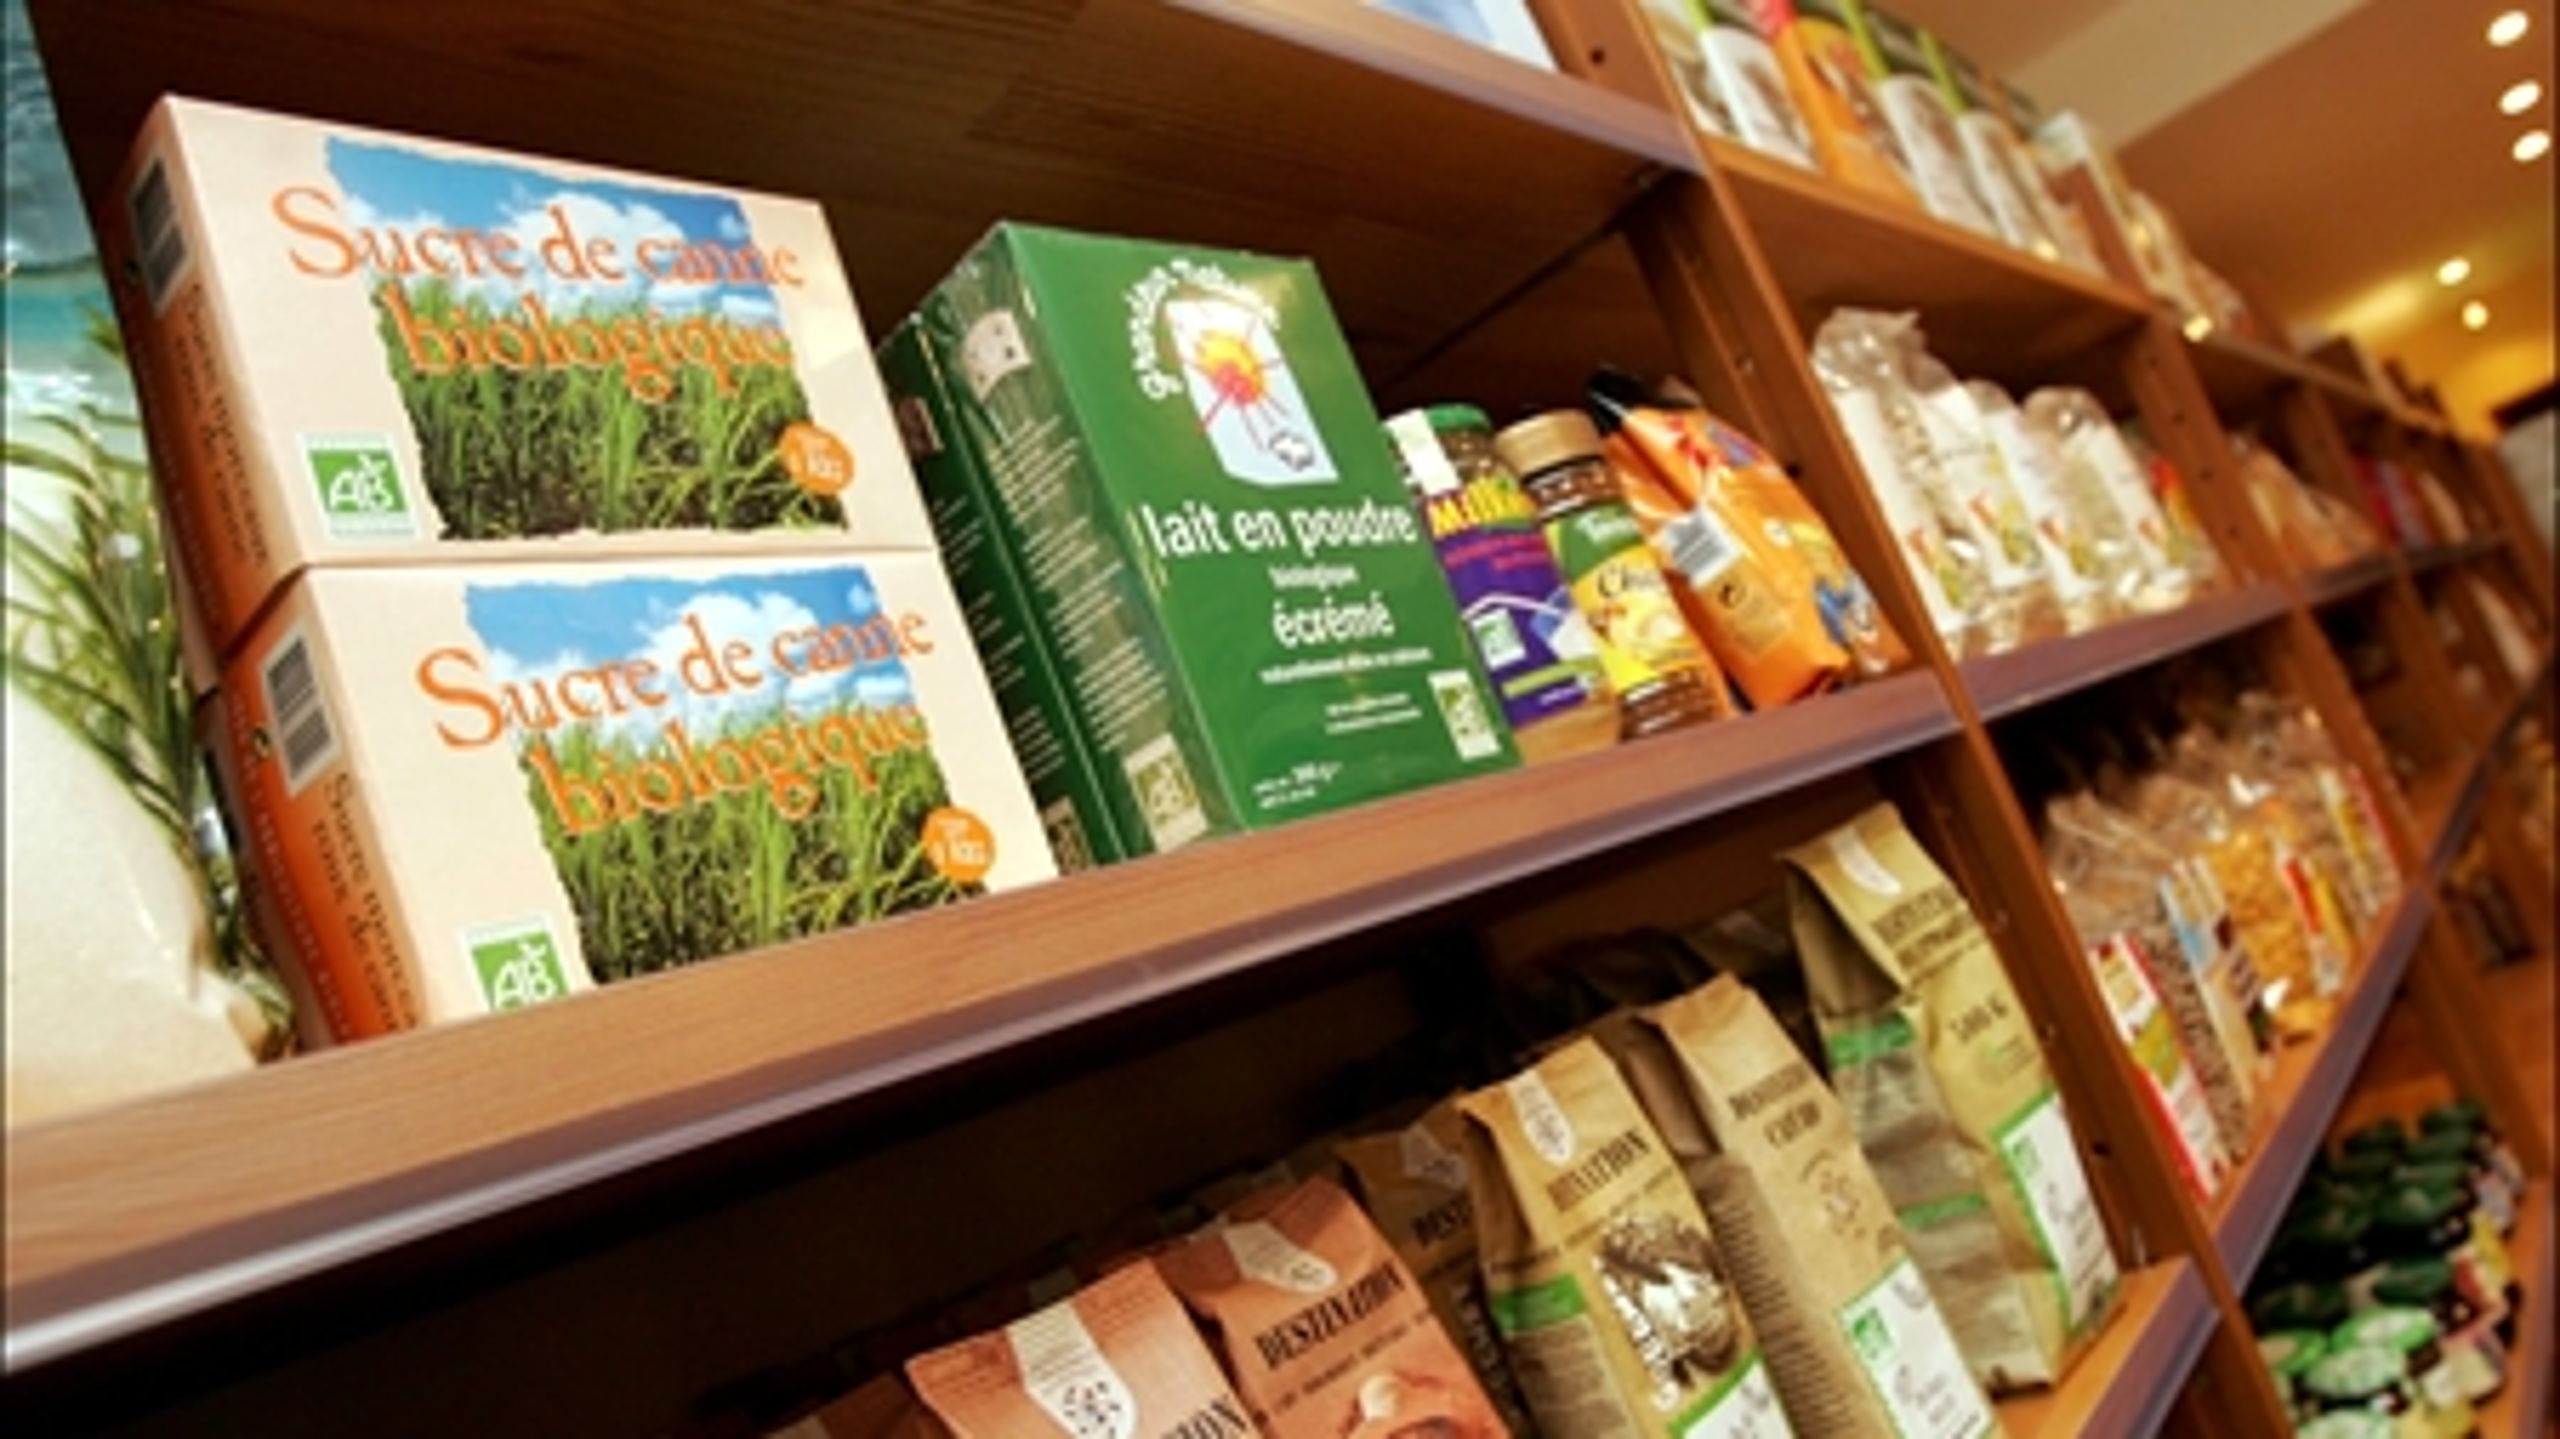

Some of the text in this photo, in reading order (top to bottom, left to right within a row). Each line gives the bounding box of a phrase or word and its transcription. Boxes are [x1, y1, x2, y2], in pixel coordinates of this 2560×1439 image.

[272, 186, 804, 287] Sucre de canne
[384, 283, 791, 403] biologique
[1142, 499, 1230, 557] lait
[1234, 509, 1288, 551] en
[1290, 495, 1418, 558] poudre
[1273, 590, 1396, 649] écrémé
[417, 612, 934, 748] Sucre de canne
[529, 704, 928, 833] biologique
